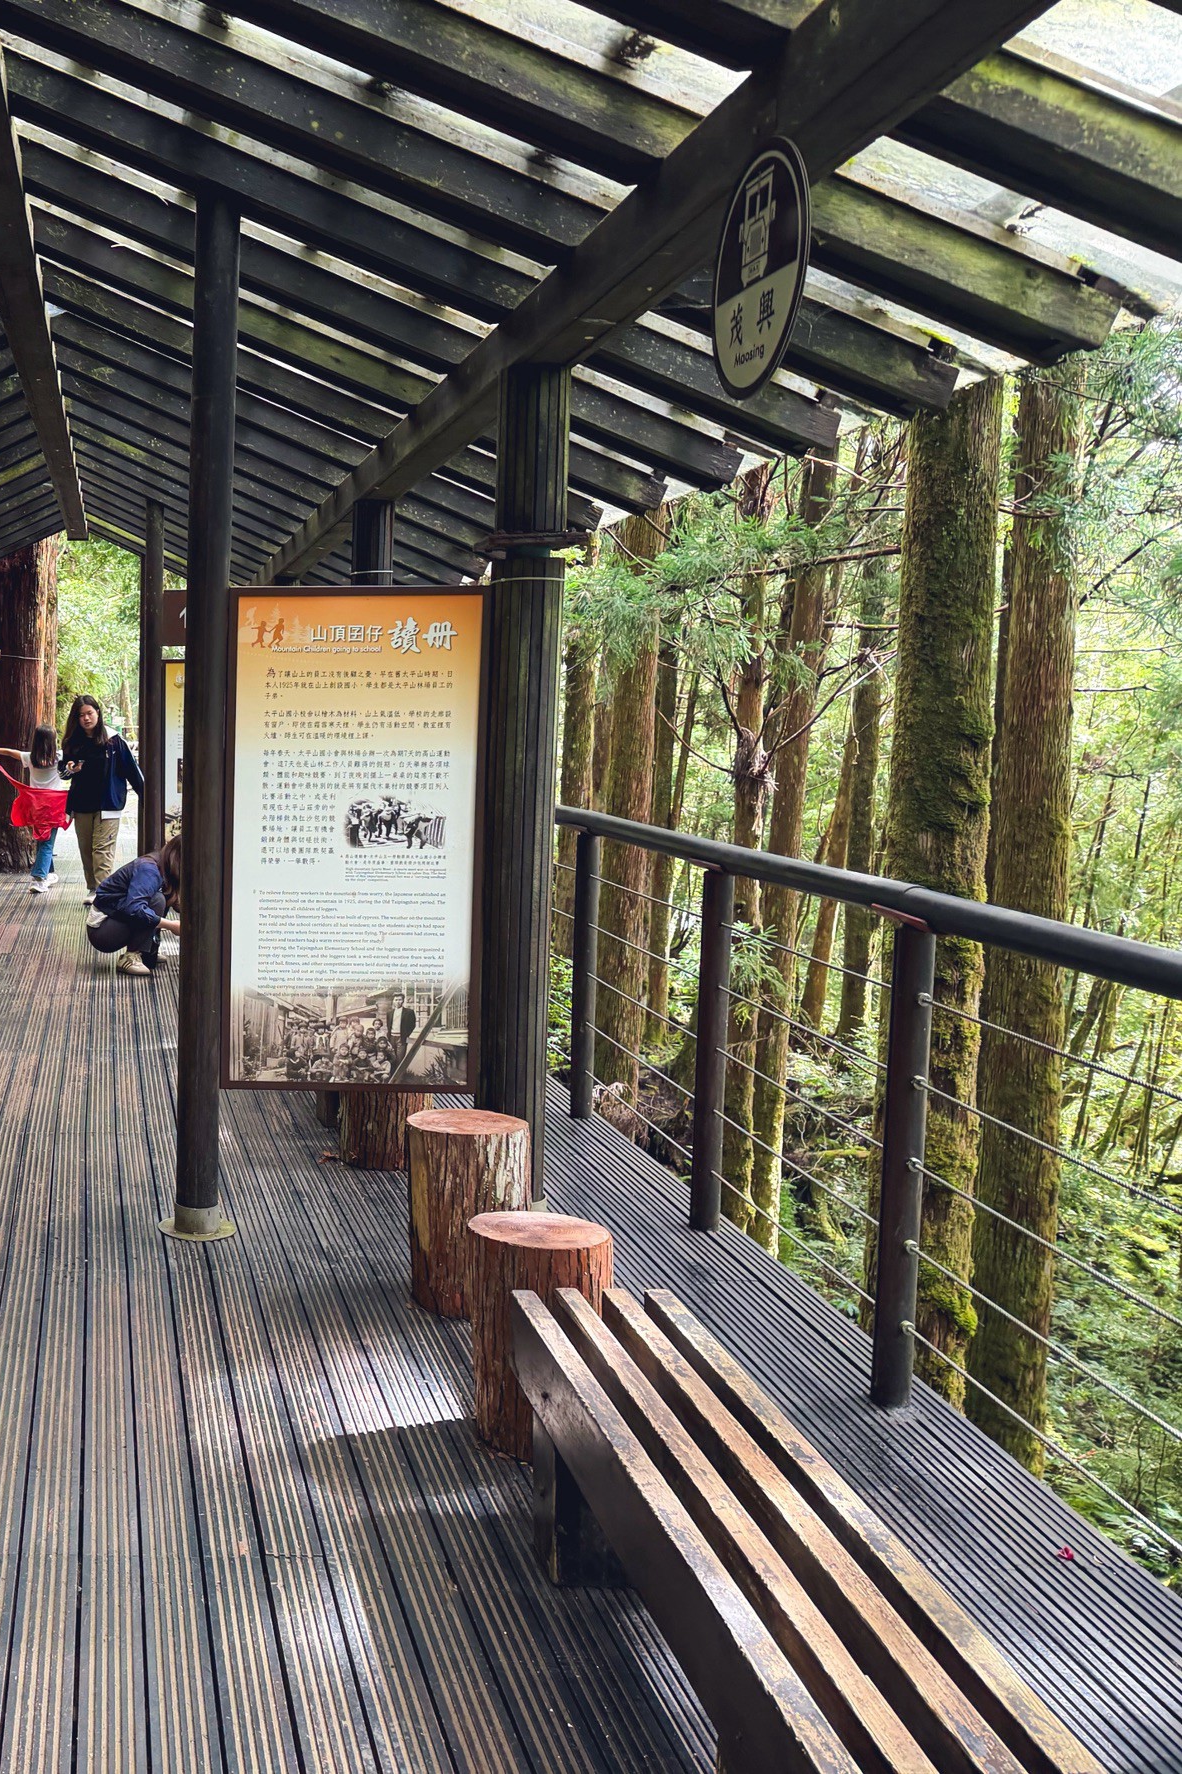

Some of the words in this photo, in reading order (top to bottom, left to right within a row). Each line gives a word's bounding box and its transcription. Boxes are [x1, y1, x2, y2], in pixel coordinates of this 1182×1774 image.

[729, 287, 775, 348] 茂興
[271, 645, 302, 653] Mountain
[303, 645, 331, 653] Children
[332, 645, 351, 654] going
[352, 645, 359, 653] to
[360, 645, 382, 653] school
[391, 898, 418, 906] Taipingshan
[296, 944, 323, 952] Taipingshan
